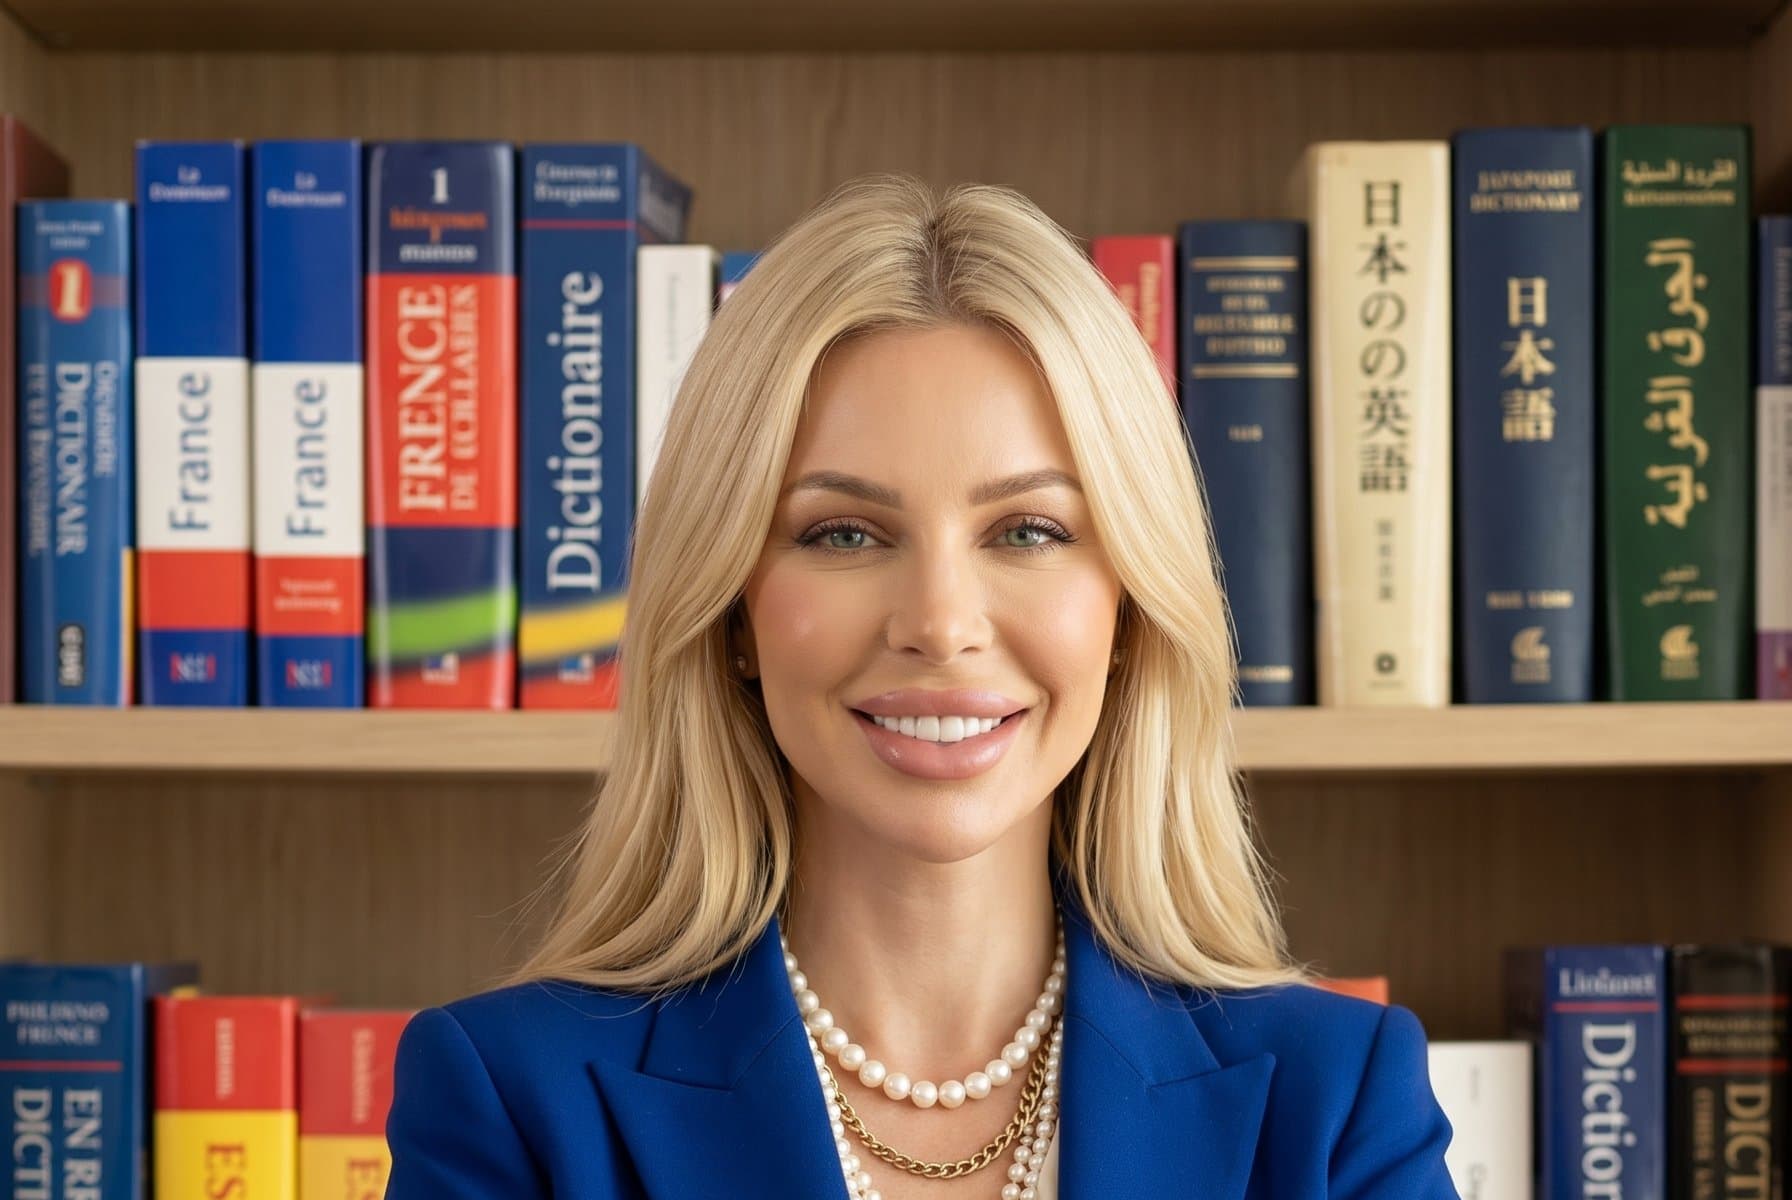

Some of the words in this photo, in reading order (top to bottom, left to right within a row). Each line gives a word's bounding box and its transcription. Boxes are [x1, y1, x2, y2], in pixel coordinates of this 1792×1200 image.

[432, 167, 450, 203] 1
[401, 285, 447, 512] FRENCE
[547, 271, 602, 592] Dictionaire
[1502, 277, 1556, 441] 日本語
[169, 372, 211, 533] France
[287, 379, 327, 538] France
